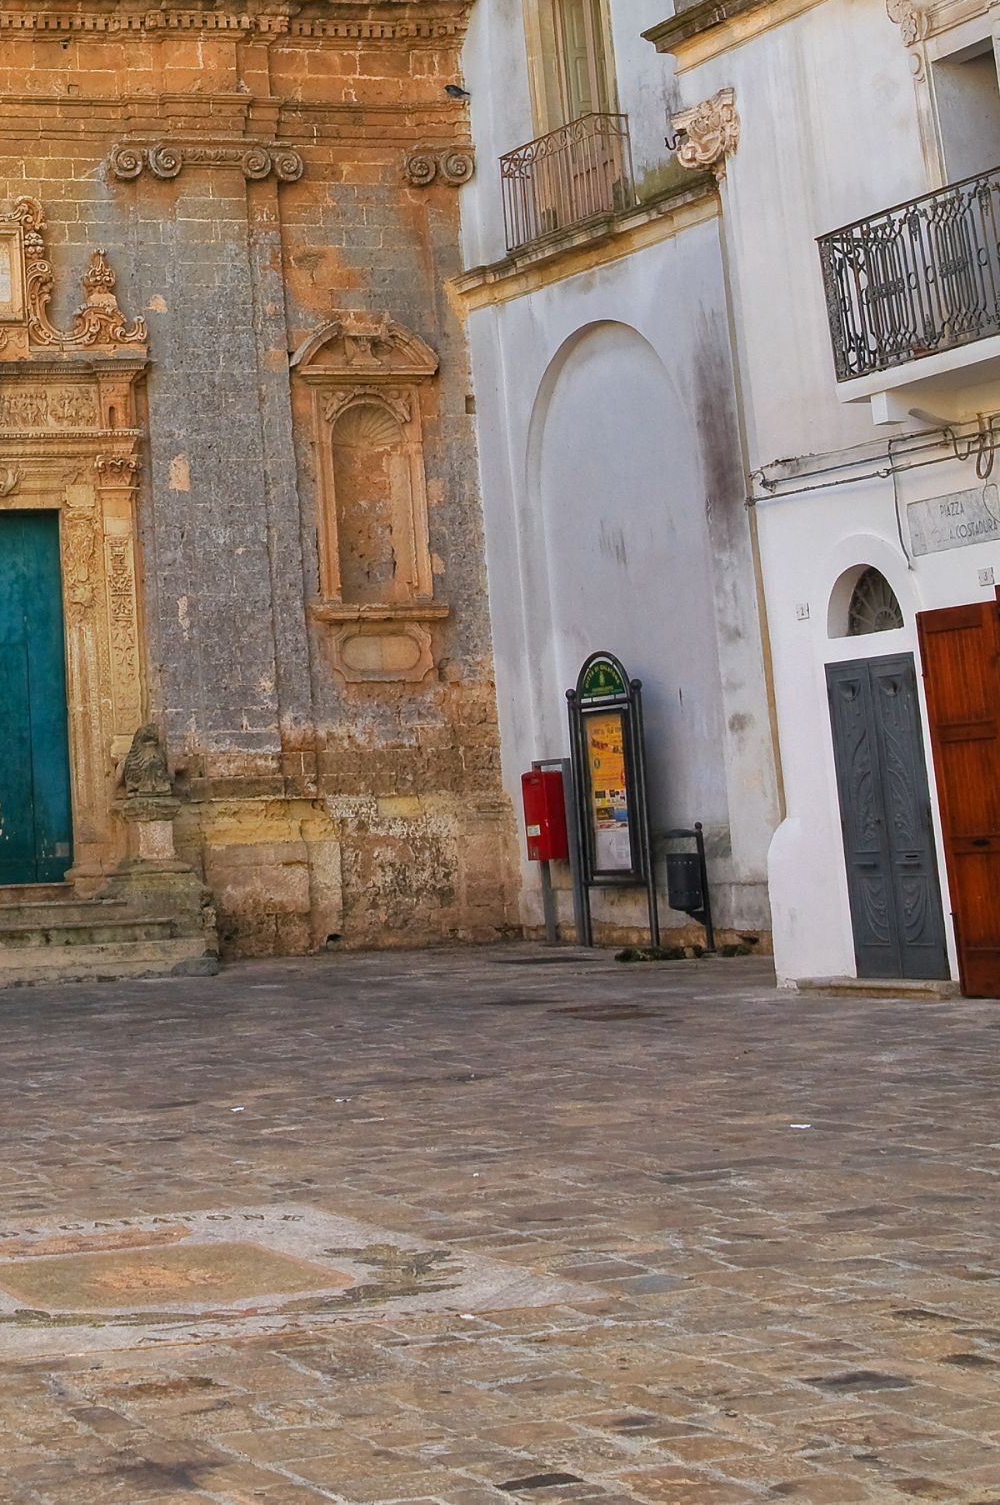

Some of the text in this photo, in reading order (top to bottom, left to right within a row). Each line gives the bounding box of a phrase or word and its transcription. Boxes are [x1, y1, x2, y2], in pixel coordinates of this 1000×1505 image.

[939, 501, 965, 517] PIAZZA
[955, 518, 998, 539] COSTADURA
[58, 1214, 305, 1231] GALATONE
